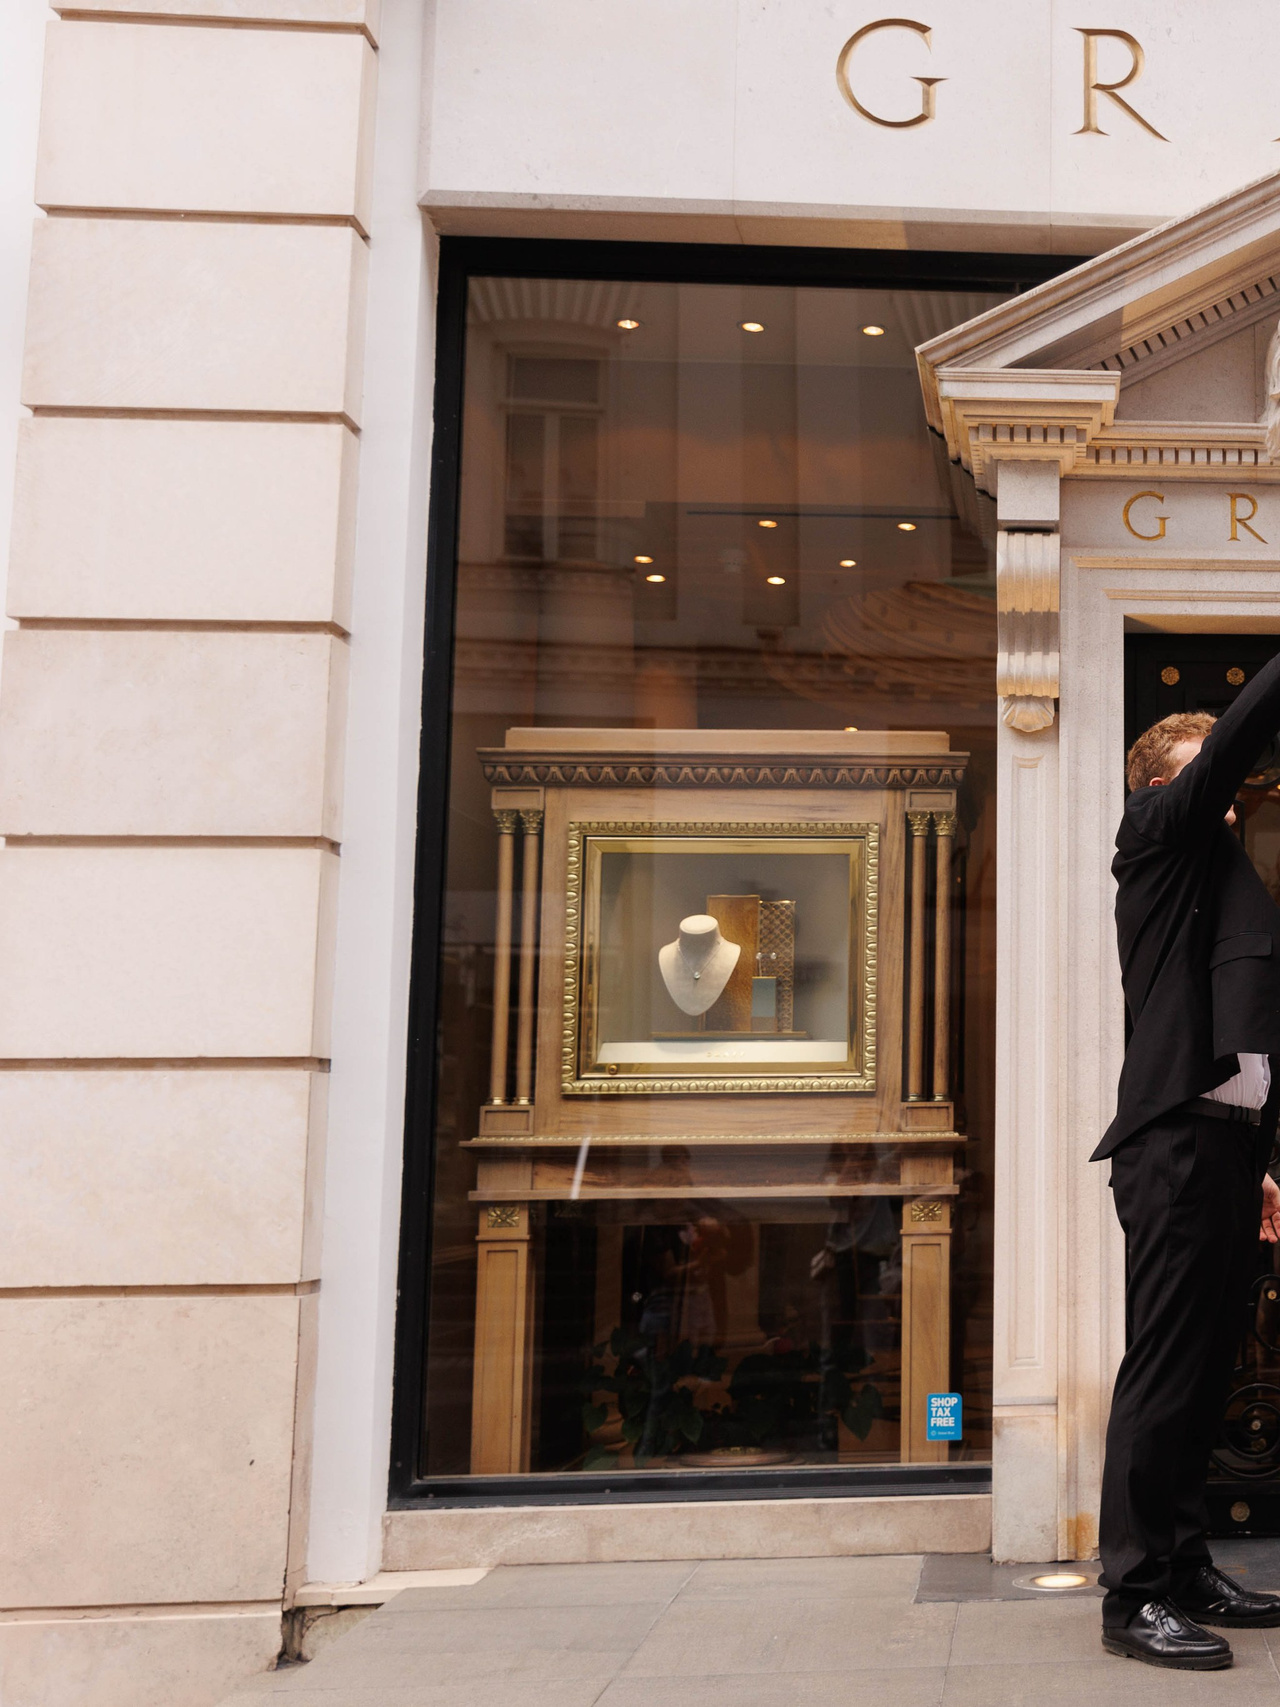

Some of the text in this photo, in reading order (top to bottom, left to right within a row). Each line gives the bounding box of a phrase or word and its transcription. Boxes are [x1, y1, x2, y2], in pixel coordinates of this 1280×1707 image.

[931, 1397, 958, 1407] SHOP
[931, 1407, 951, 1417] TAX
[931, 1417, 955, 1427] FREE
